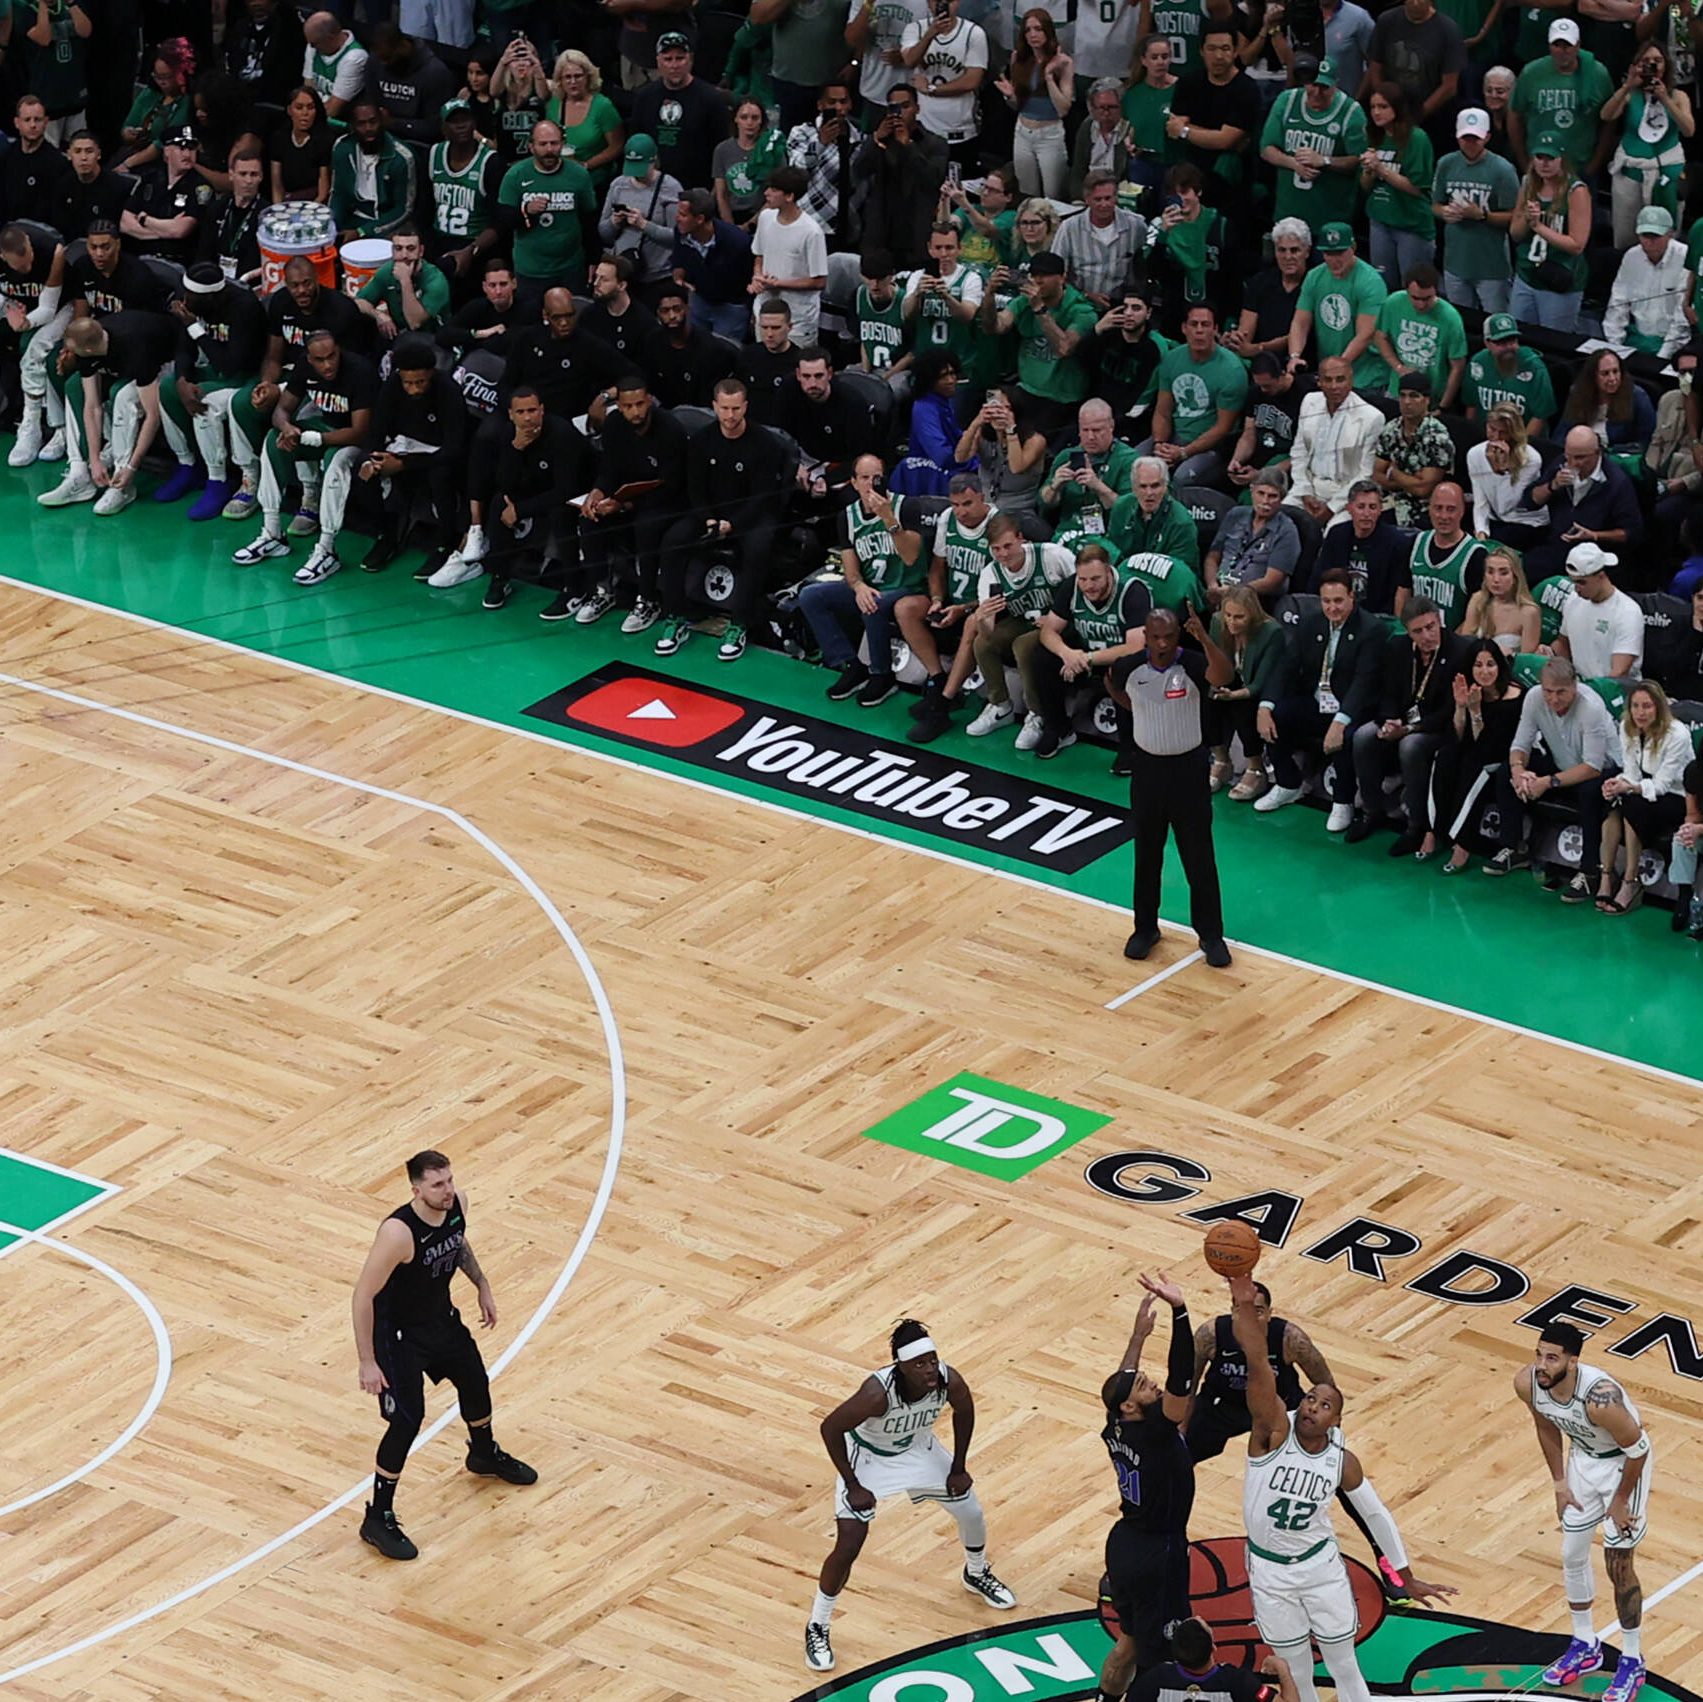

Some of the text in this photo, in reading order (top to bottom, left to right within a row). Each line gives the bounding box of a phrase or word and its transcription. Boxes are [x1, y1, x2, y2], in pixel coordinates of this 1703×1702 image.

[1155, 11, 1200, 37] BOSTON
[438, 204, 469, 237] 42
[860, 320, 902, 347] BOSTON
[932, 321, 948, 345] 0
[855, 531, 897, 562] BOSTON
[871, 559, 888, 584] 7
[1127, 552, 1174, 581] BOSTON
[953, 570, 970, 600] 7
[921, 1087, 1068, 1160] TD
[1268, 1465, 1332, 1502] CELTICS
[1266, 1497, 1319, 1531] 42
